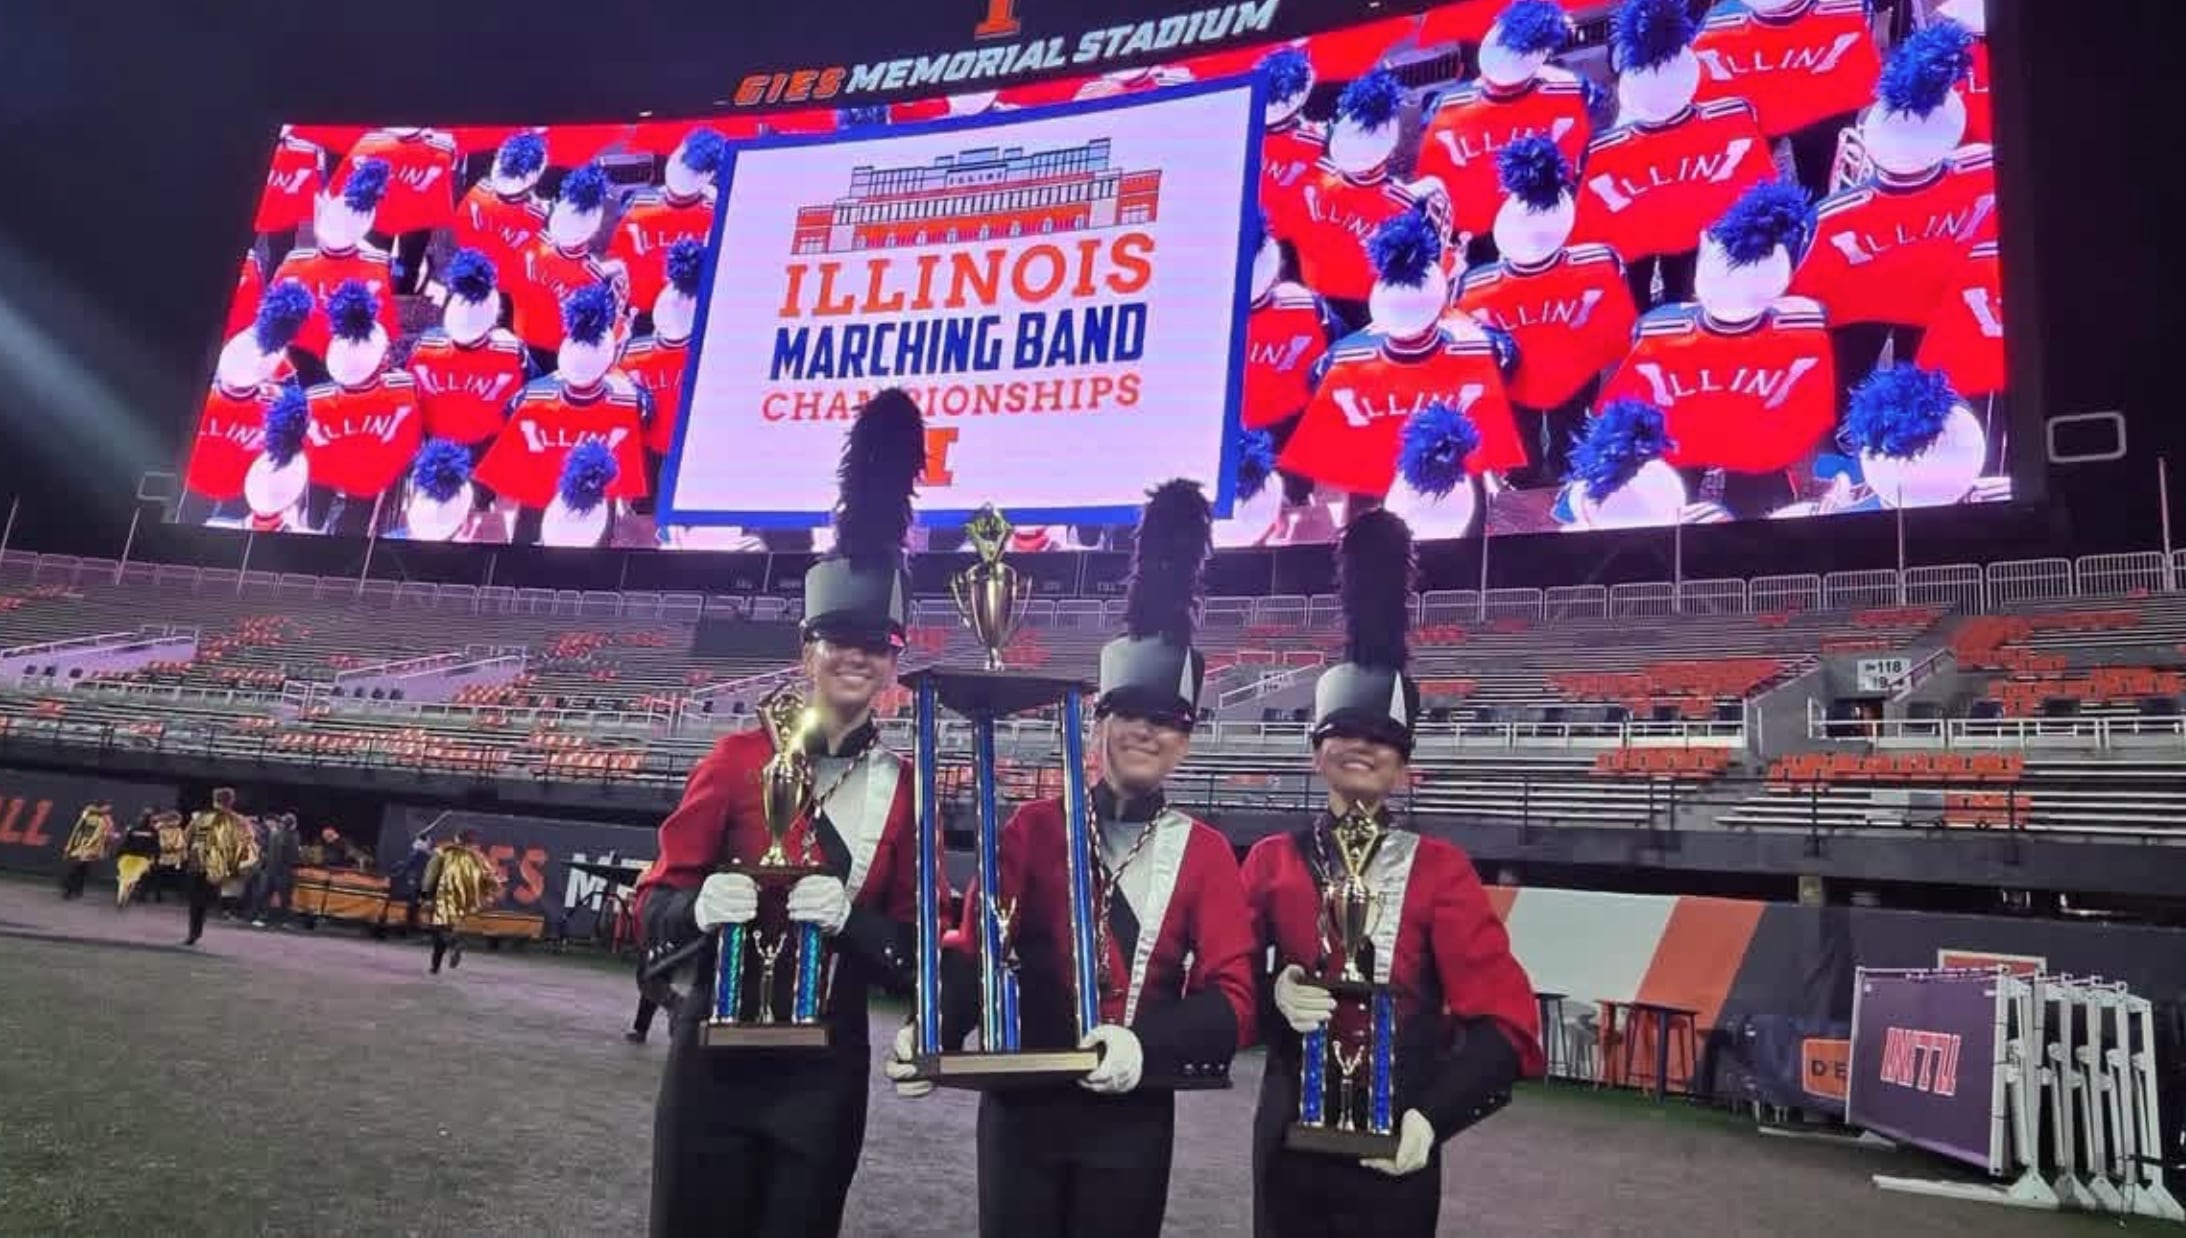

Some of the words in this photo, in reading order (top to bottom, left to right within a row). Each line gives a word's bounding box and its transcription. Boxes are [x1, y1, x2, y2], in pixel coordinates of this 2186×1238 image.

[735, 67, 843, 105] GIES
[846, 41, 1066, 94] MEMORIAL
[1073, 0, 1279, 63] STADIUM
[1696, 32, 1861, 80] ILLINI
[1588, 138, 1752, 213] ILLINI
[1829, 194, 1996, 266] ILLINI
[779, 233, 1156, 317] ILLINOIS
[769, 315, 1001, 380] MARCHING
[1013, 303, 1147, 369] BAND
[413, 364, 513, 400] ILLINI
[762, 373, 1141, 421] CHAIONSHIPS
[1634, 357, 1819, 408] ILLINI
[306, 406, 411, 447] ILLINI
